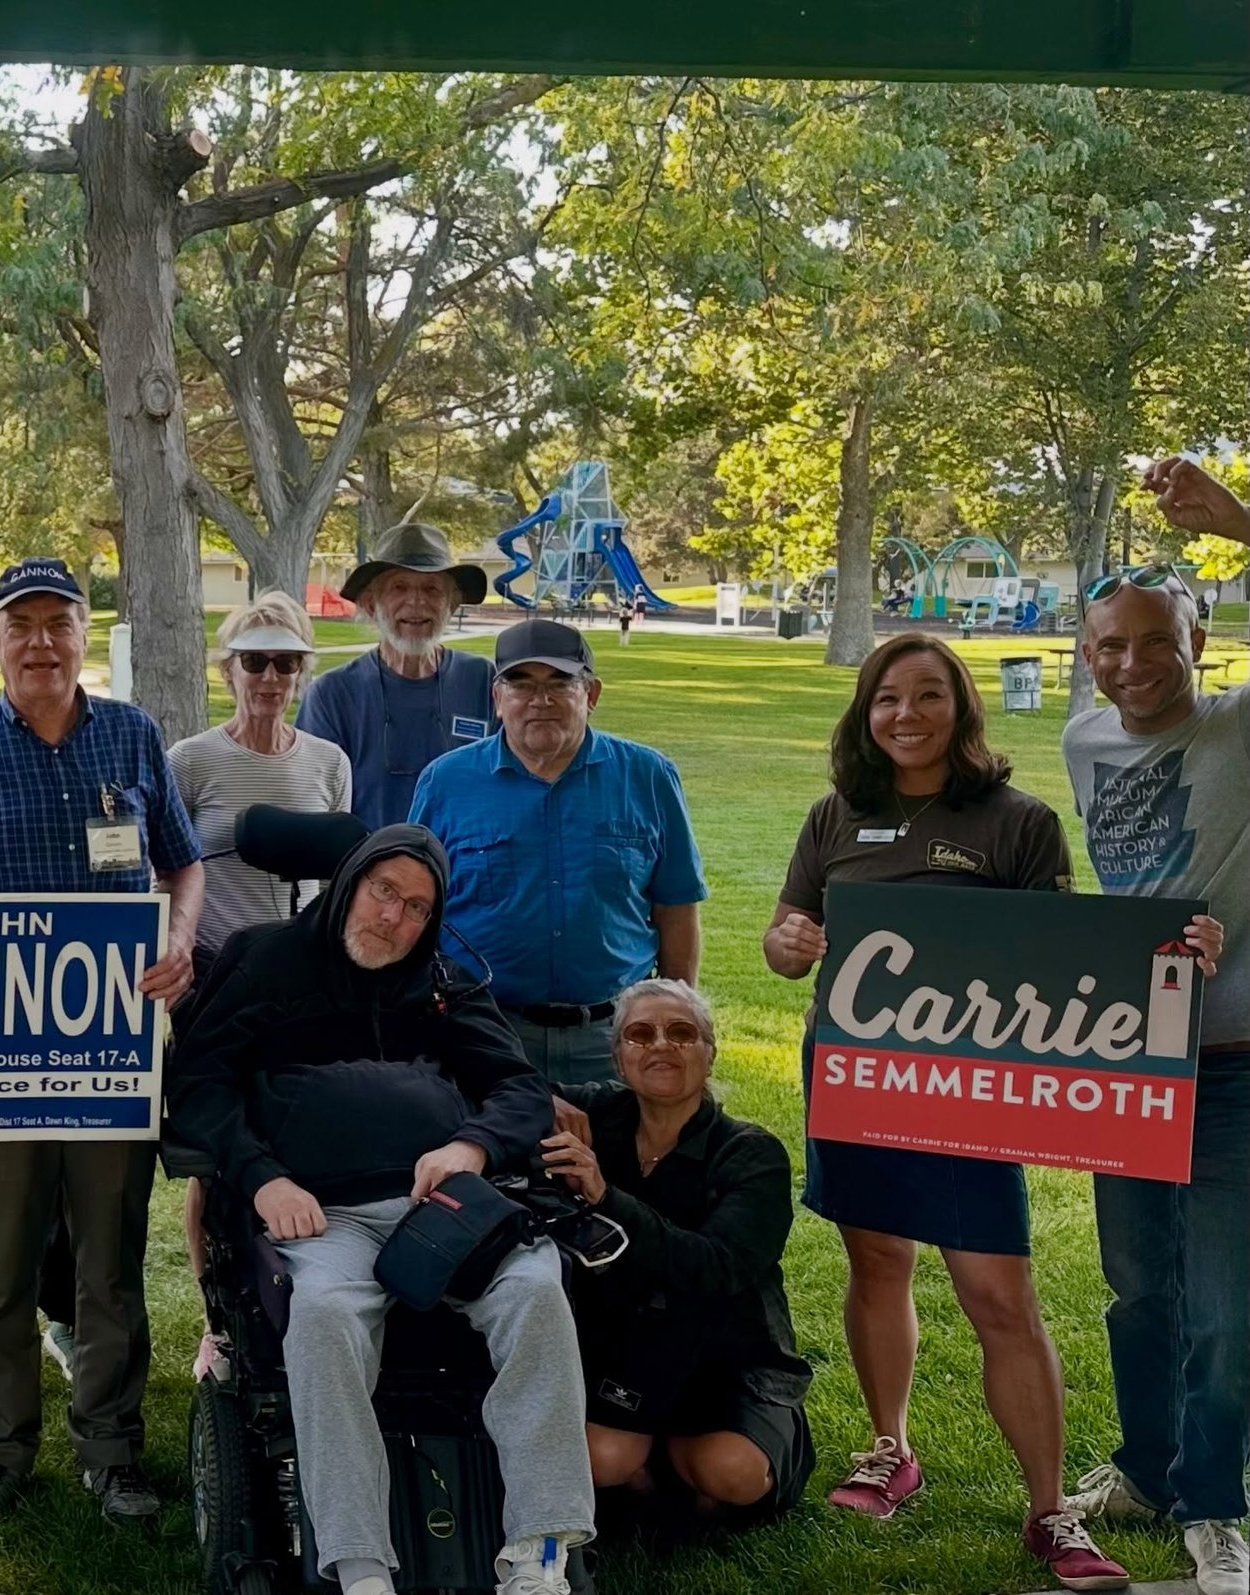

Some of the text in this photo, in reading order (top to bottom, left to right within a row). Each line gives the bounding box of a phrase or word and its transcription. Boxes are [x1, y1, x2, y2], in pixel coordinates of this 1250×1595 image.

[10, 567, 66, 583] GANNON
[1104, 767, 1168, 792] ATIAL
[1098, 801, 1152, 823] RICAN
[1092, 815, 1170, 841] AMERICAN
[1095, 837, 1167, 858] HISTORY &
[1100, 854, 1163, 874] CULTURE
[828, 930, 1144, 1060] Carrie
[47, 1050, 91, 1066] Seat
[97, 1050, 141, 1066] 17-A
[39, 1076, 83, 1092] for
[91, 1076, 139, 1092] Us!
[825, 1054, 1175, 1120] SEMMELROTH
[13, 1117, 21, 1125] 17
[22, 1116, 36, 1126] Seat
[82, 1116, 111, 1125] Treasurer
[862, 1131, 881, 1139] PAID
[883, 1133, 899, 1141] FOR
[912, 1137, 942, 1147] CARRIE
[943, 1141, 960, 1149] FOR
[962, 1143, 989, 1152] IDAHO
[999, 1147, 1036, 1158] GRAHAM
[1075, 1156, 1125, 1168] TREASURER
